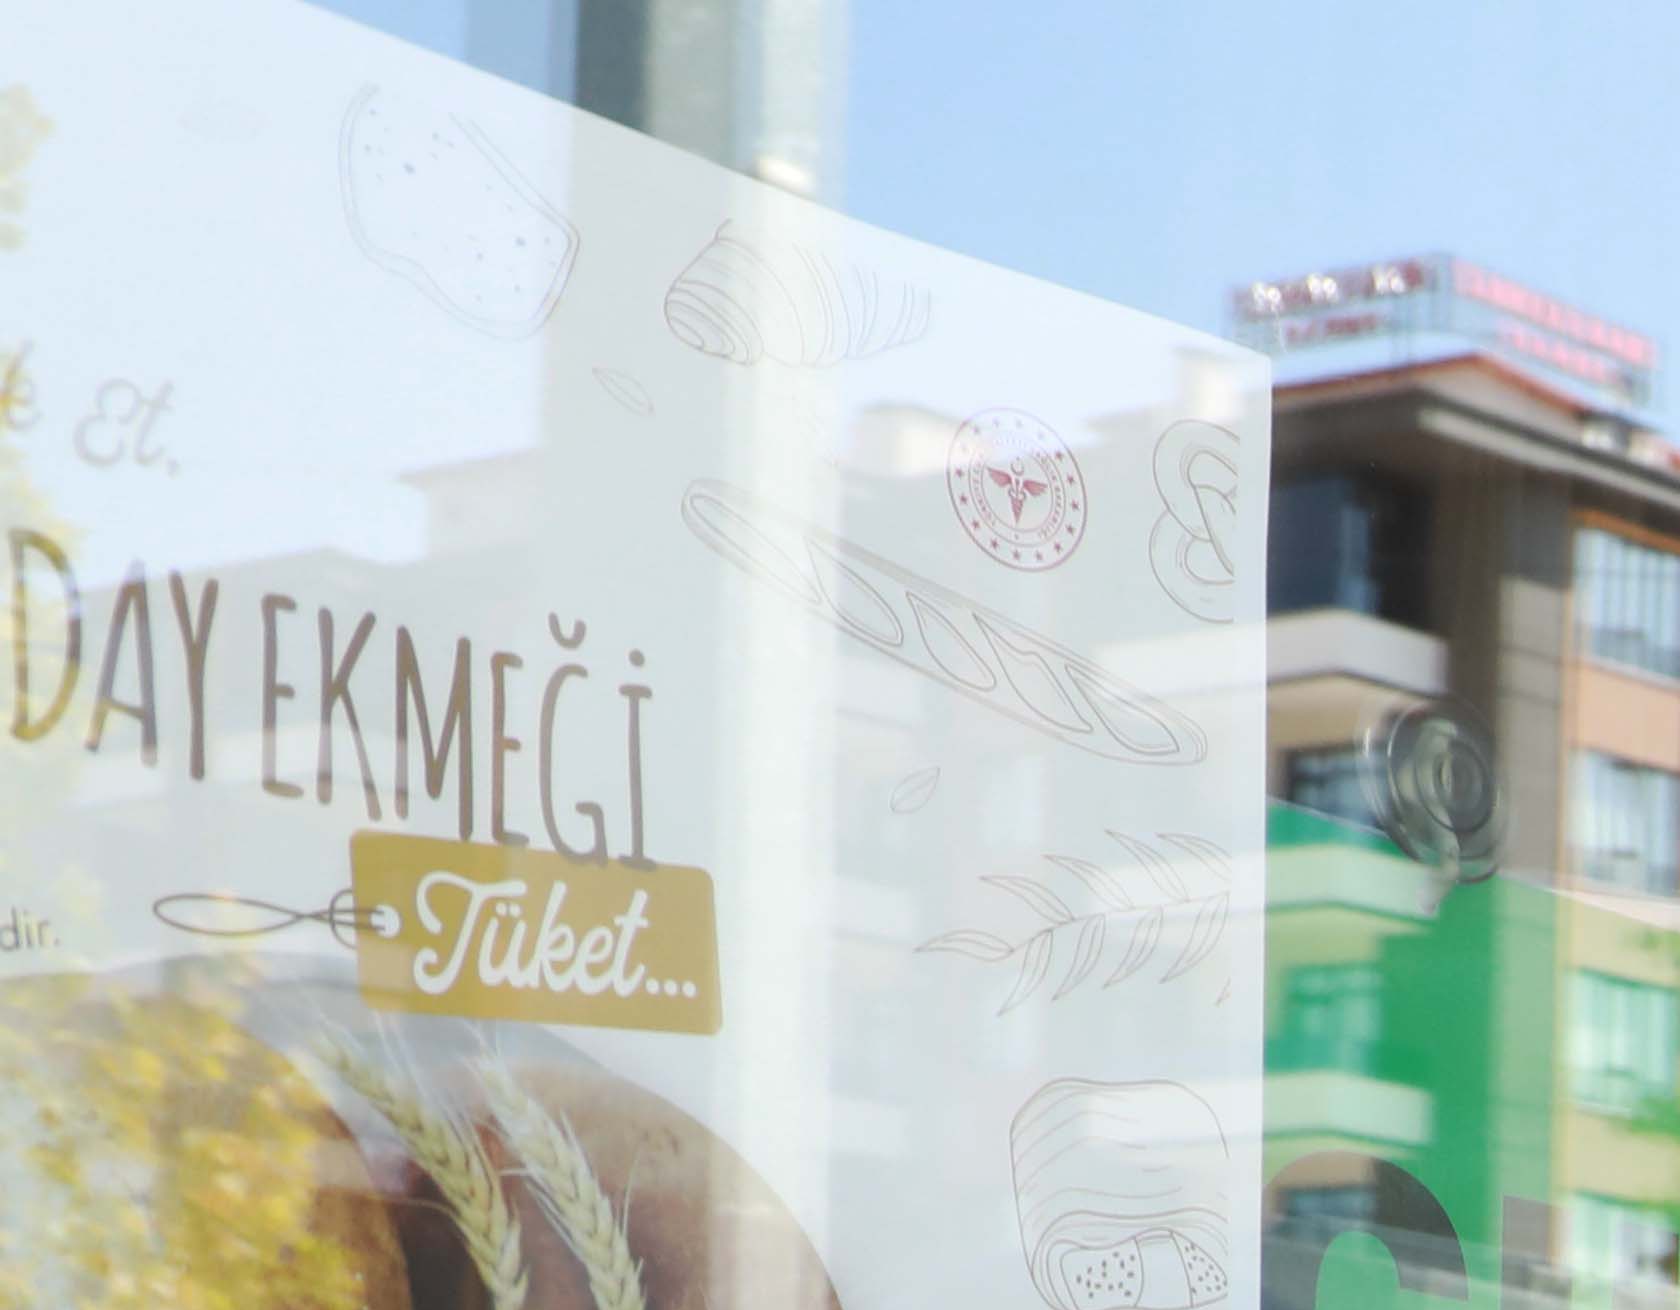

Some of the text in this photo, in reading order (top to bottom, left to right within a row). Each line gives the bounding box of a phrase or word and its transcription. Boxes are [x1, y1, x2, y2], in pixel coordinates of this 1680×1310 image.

[9, 527, 658, 872] DAY EKMEĞİ
[411, 869, 697, 999] Tüket...
